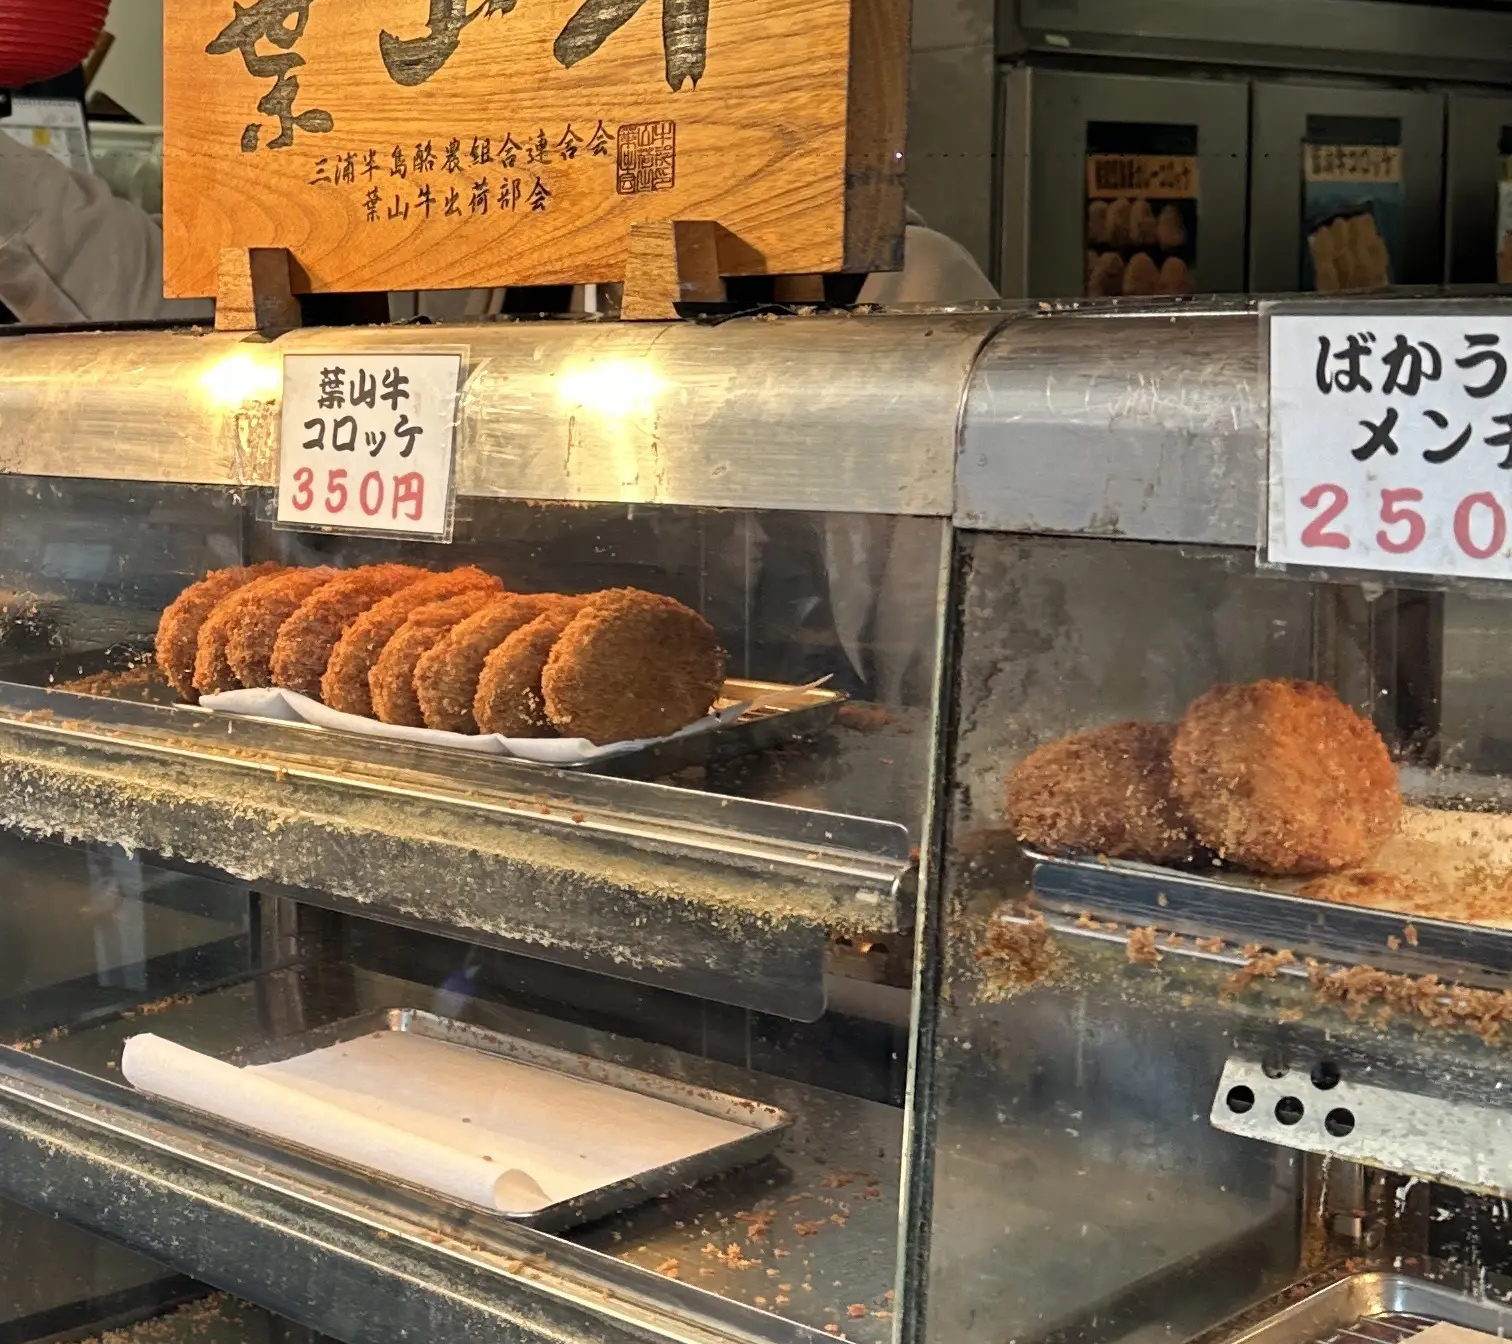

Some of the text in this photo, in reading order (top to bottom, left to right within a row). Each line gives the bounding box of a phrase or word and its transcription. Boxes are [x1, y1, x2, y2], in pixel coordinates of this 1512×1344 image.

[308, 119, 615, 187] 三浦半島酪農組合連合会
[363, 177, 552, 223] 葉山牛出荷部会
[317, 366, 410, 410] 葉山牛
[1317, 331, 1508, 399] ばかう
[302, 415, 424, 457] コロッケ
[291, 467, 425, 521] 350円
[1300, 483, 1507, 560] 250
